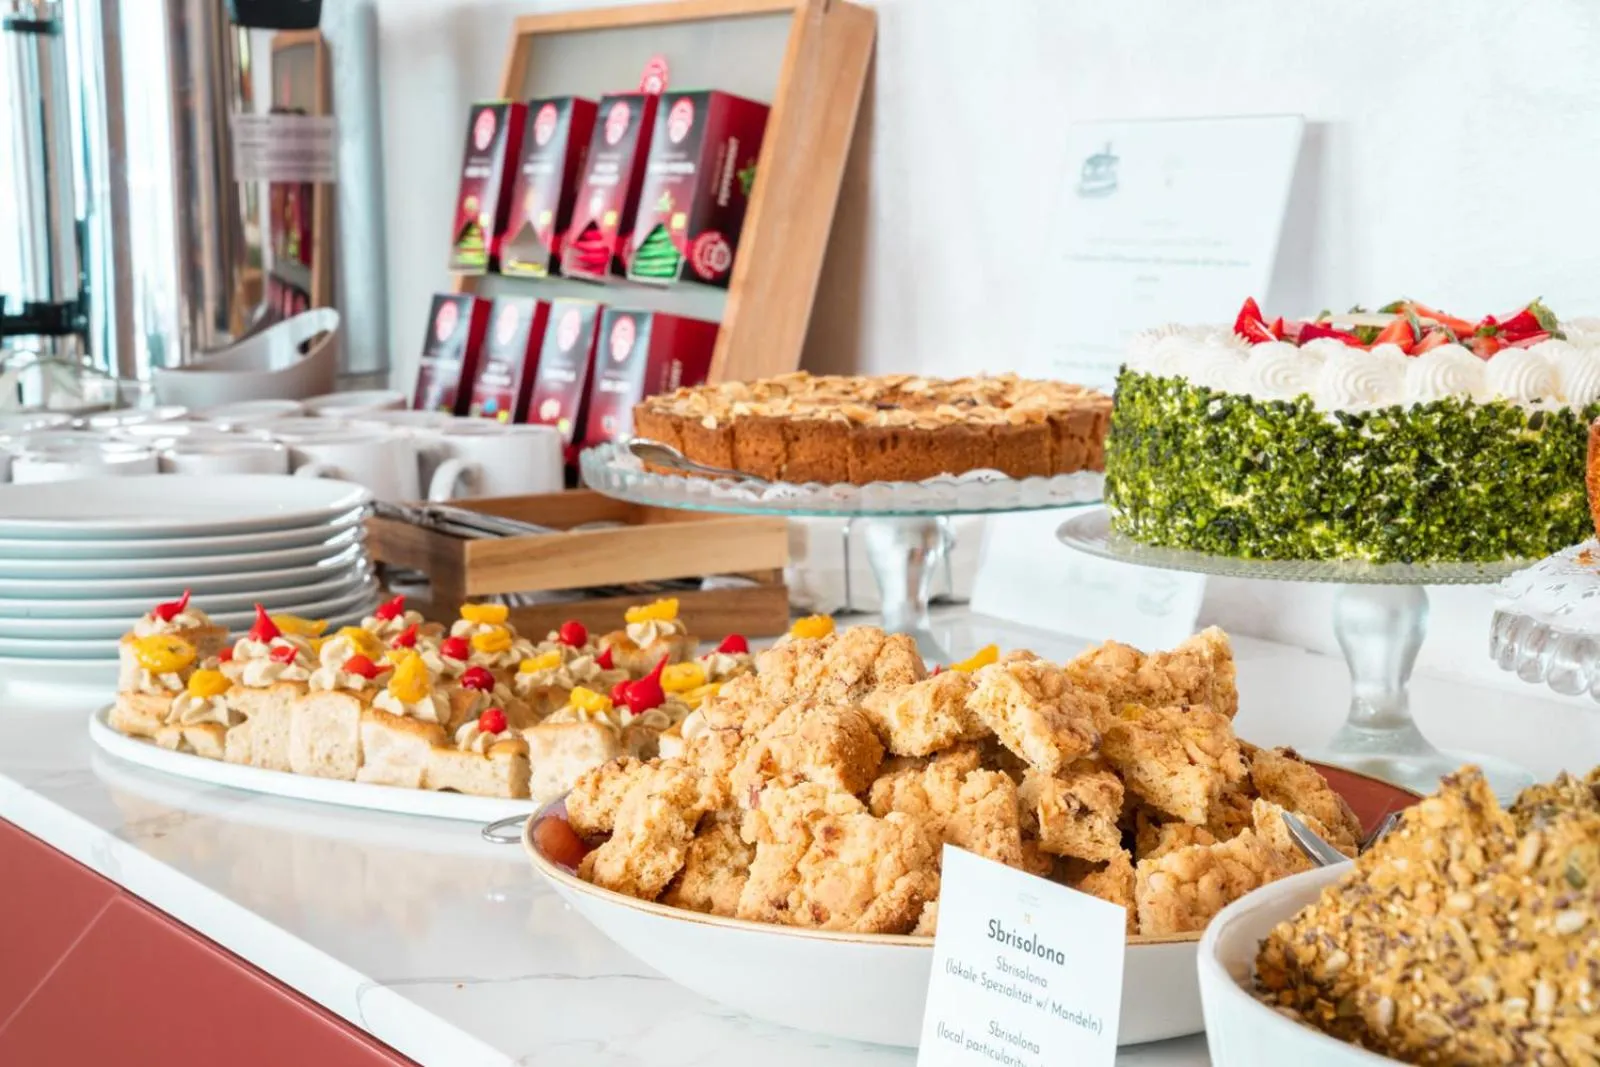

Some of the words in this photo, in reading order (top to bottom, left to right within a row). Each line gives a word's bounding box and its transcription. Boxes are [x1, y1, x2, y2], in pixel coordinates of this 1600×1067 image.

[987, 918, 1065, 966] Sbrisolona
[996, 955, 1048, 988] Sbrisolona
[945, 957, 978, 983] (lokale
[980, 972, 1033, 1004] Spezialität
[1051, 1001, 1103, 1035] Mandeln)
[937, 1020, 964, 1046] (local
[988, 1019, 1040, 1054] Sbrisolona
